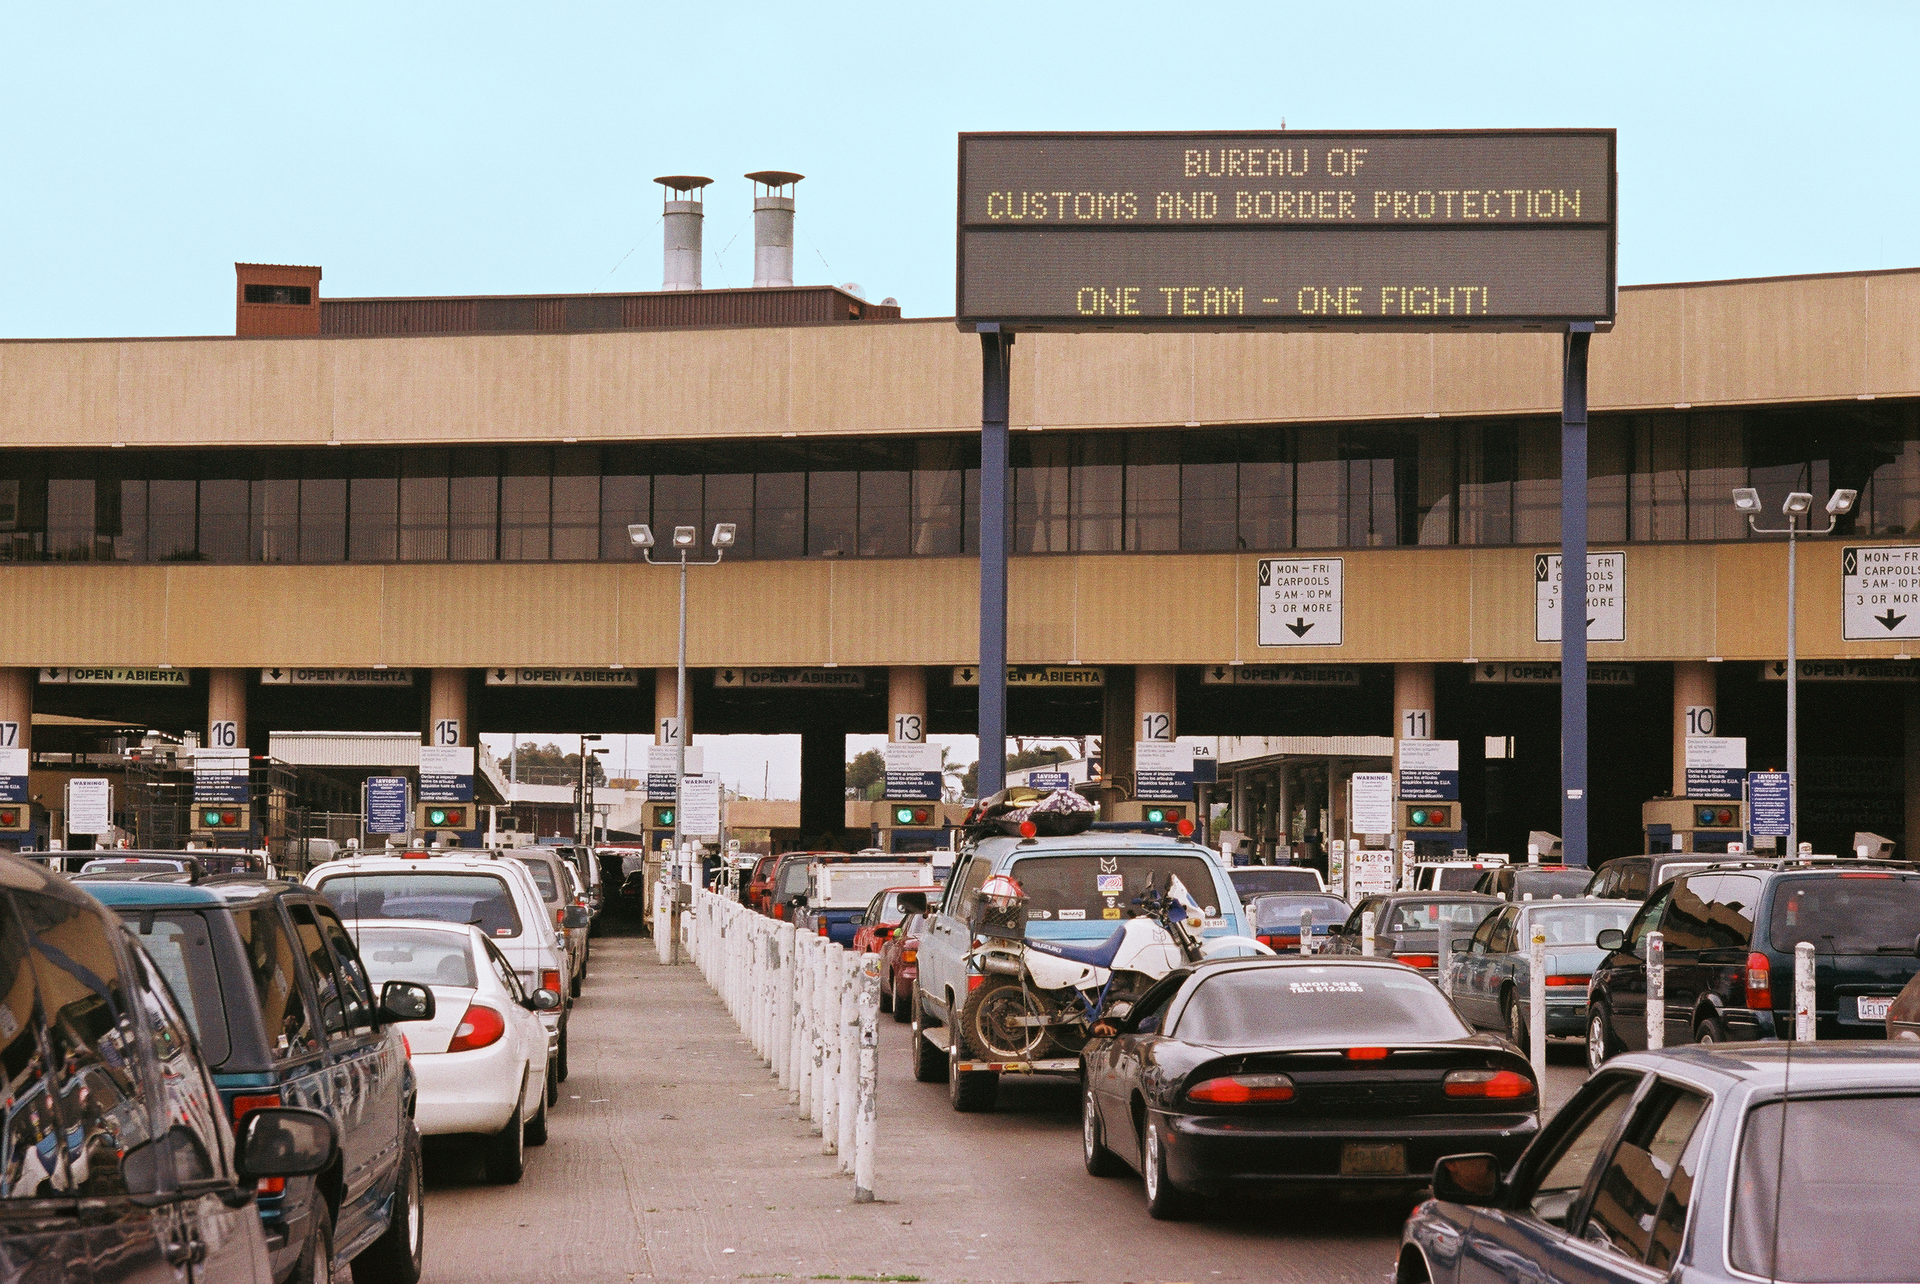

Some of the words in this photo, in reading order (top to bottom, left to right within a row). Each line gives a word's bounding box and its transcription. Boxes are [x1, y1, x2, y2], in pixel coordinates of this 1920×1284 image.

[1184, 148, 1309, 177] BUREAU
[1327, 148, 1368, 177] OF
[987, 191, 1138, 220] CUSTOMS
[1156, 191, 1218, 220] AND
[1235, 190, 1356, 219] BORDER
[1373, 189, 1581, 219] PROTECTION
[1076, 286, 1141, 315] ONE
[1158, 286, 1244, 315] TEAM
[1297, 286, 1363, 315] ONE
[1381, 286, 1488, 315] FIGHT!
[1598, 558, 1614, 567] FRI
[1864, 553, 1889, 562] MON
[1904, 552, 1920, 561] FR
[1277, 565, 1299, 574] MON
[1312, 564, 1329, 573] FRI
[1277, 576, 1330, 586] CARPOOLS
[1862, 579, 1869, 589] 5
[1872, 579, 1888, 588] AM
[1898, 579, 1908, 588] 10
[1911, 578, 1920, 588] P
[1275, 590, 1281, 599] 5
[1283, 590, 1298, 599] AM
[1306, 589, 1315, 598] 10
[1318, 589, 1332, 598] PM
[1552, 585, 1558, 594] 5
[1598, 583, 1613, 593] PM
[1548, 598, 1554, 609] 3
[1856, 594, 1864, 606] 3
[1870, 594, 1887, 604] OR
[1893, 594, 1918, 604] MOR
[1270, 604, 1276, 614] 3
[1282, 604, 1297, 613] OR
[1302, 603, 1332, 612] MORE
[74, 669, 114, 680] OPEN
[124, 670, 185, 682] ABIERTA
[297, 670, 335, 680] OPEN
[346, 670, 408, 682] ABIERTA
[522, 670, 562, 681] OPEN
[573, 671, 633, 682] ABIERTA
[750, 672, 789, 682] OPEN
[800, 672, 860, 684] ABIERTA
[1039, 671, 1101, 682] ABIERTA
[1240, 669, 1280, 680] OPEN
[1512, 667, 1552, 678] OPEN
[1143, 714, 1170, 740] 12
[1406, 712, 1426, 737] 11
[1686, 708, 1714, 735] 10
[436, 722, 458, 744] 15
[896, 716, 921, 740] 13
[212, 722, 236, 747] 16
[1032, 941, 1062, 954] SUZUKI
